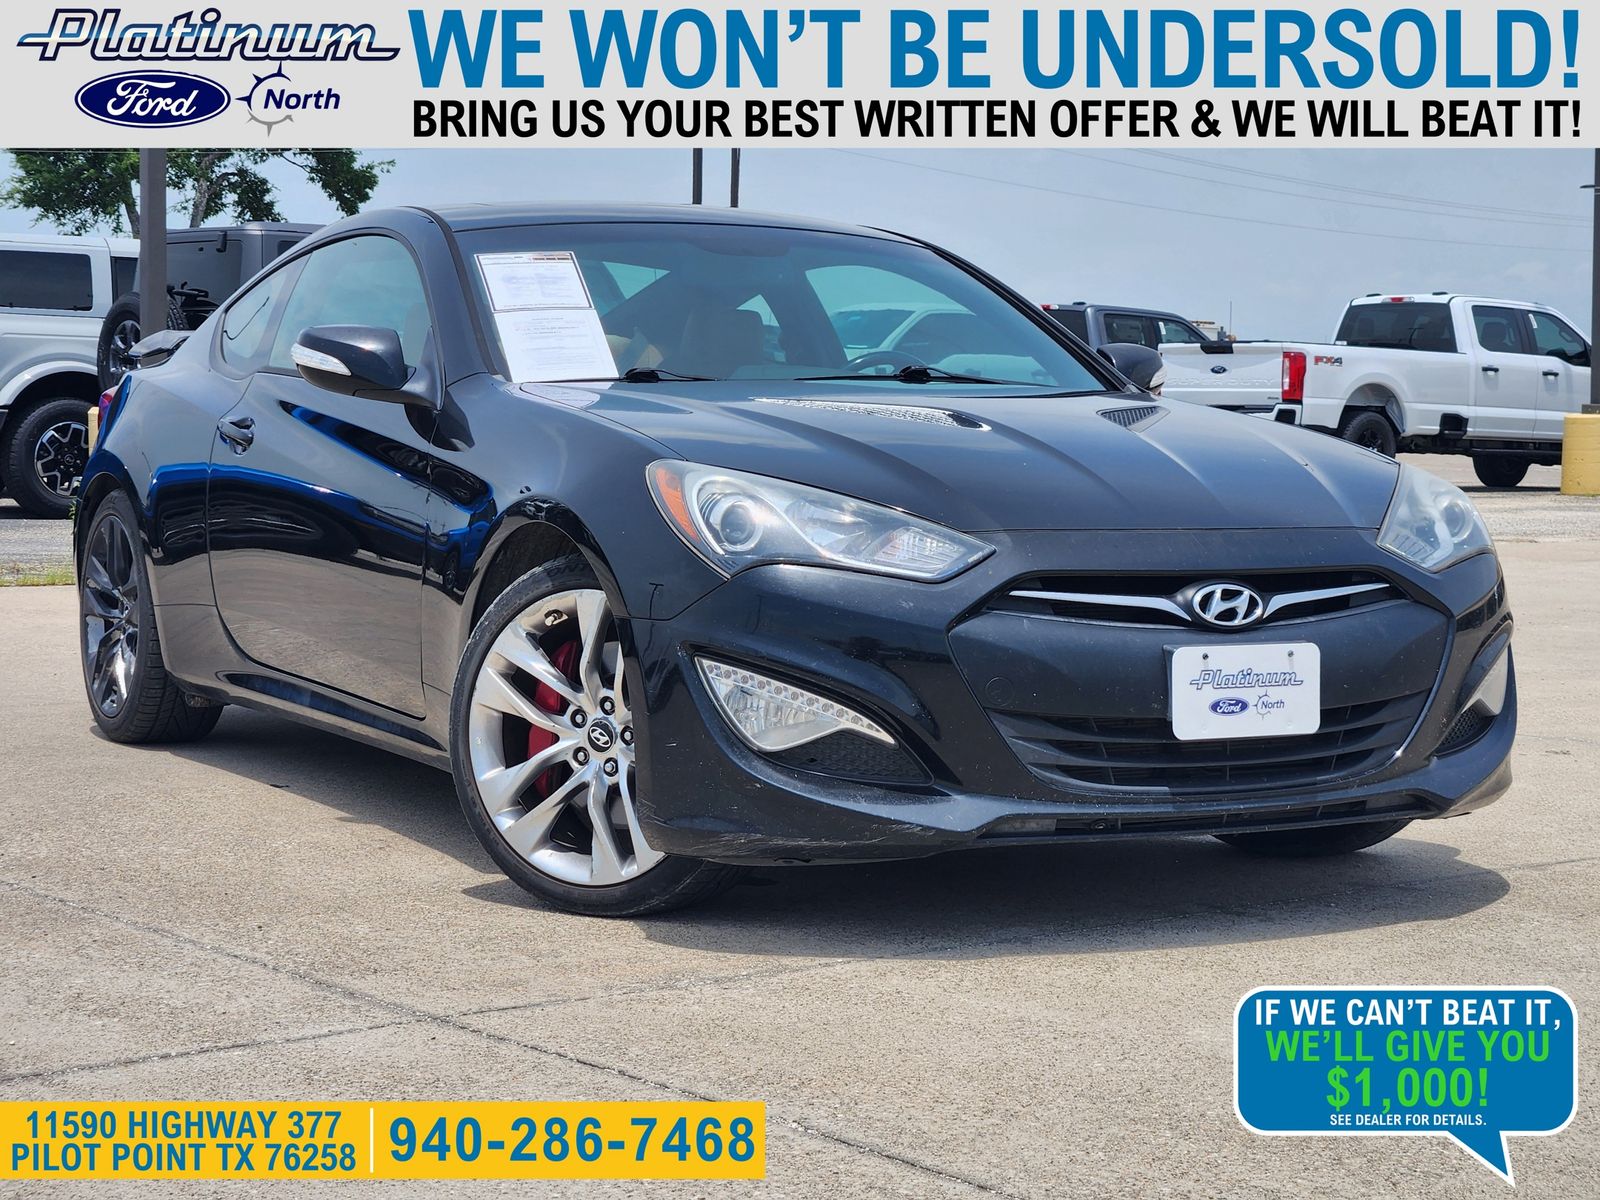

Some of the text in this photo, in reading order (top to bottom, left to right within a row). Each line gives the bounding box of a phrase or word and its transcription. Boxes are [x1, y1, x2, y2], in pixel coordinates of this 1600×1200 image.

[1314, 356, 1343, 366] FX4
[1190, 668, 1304, 690] Platinum
[1260, 700, 1285, 709] North
